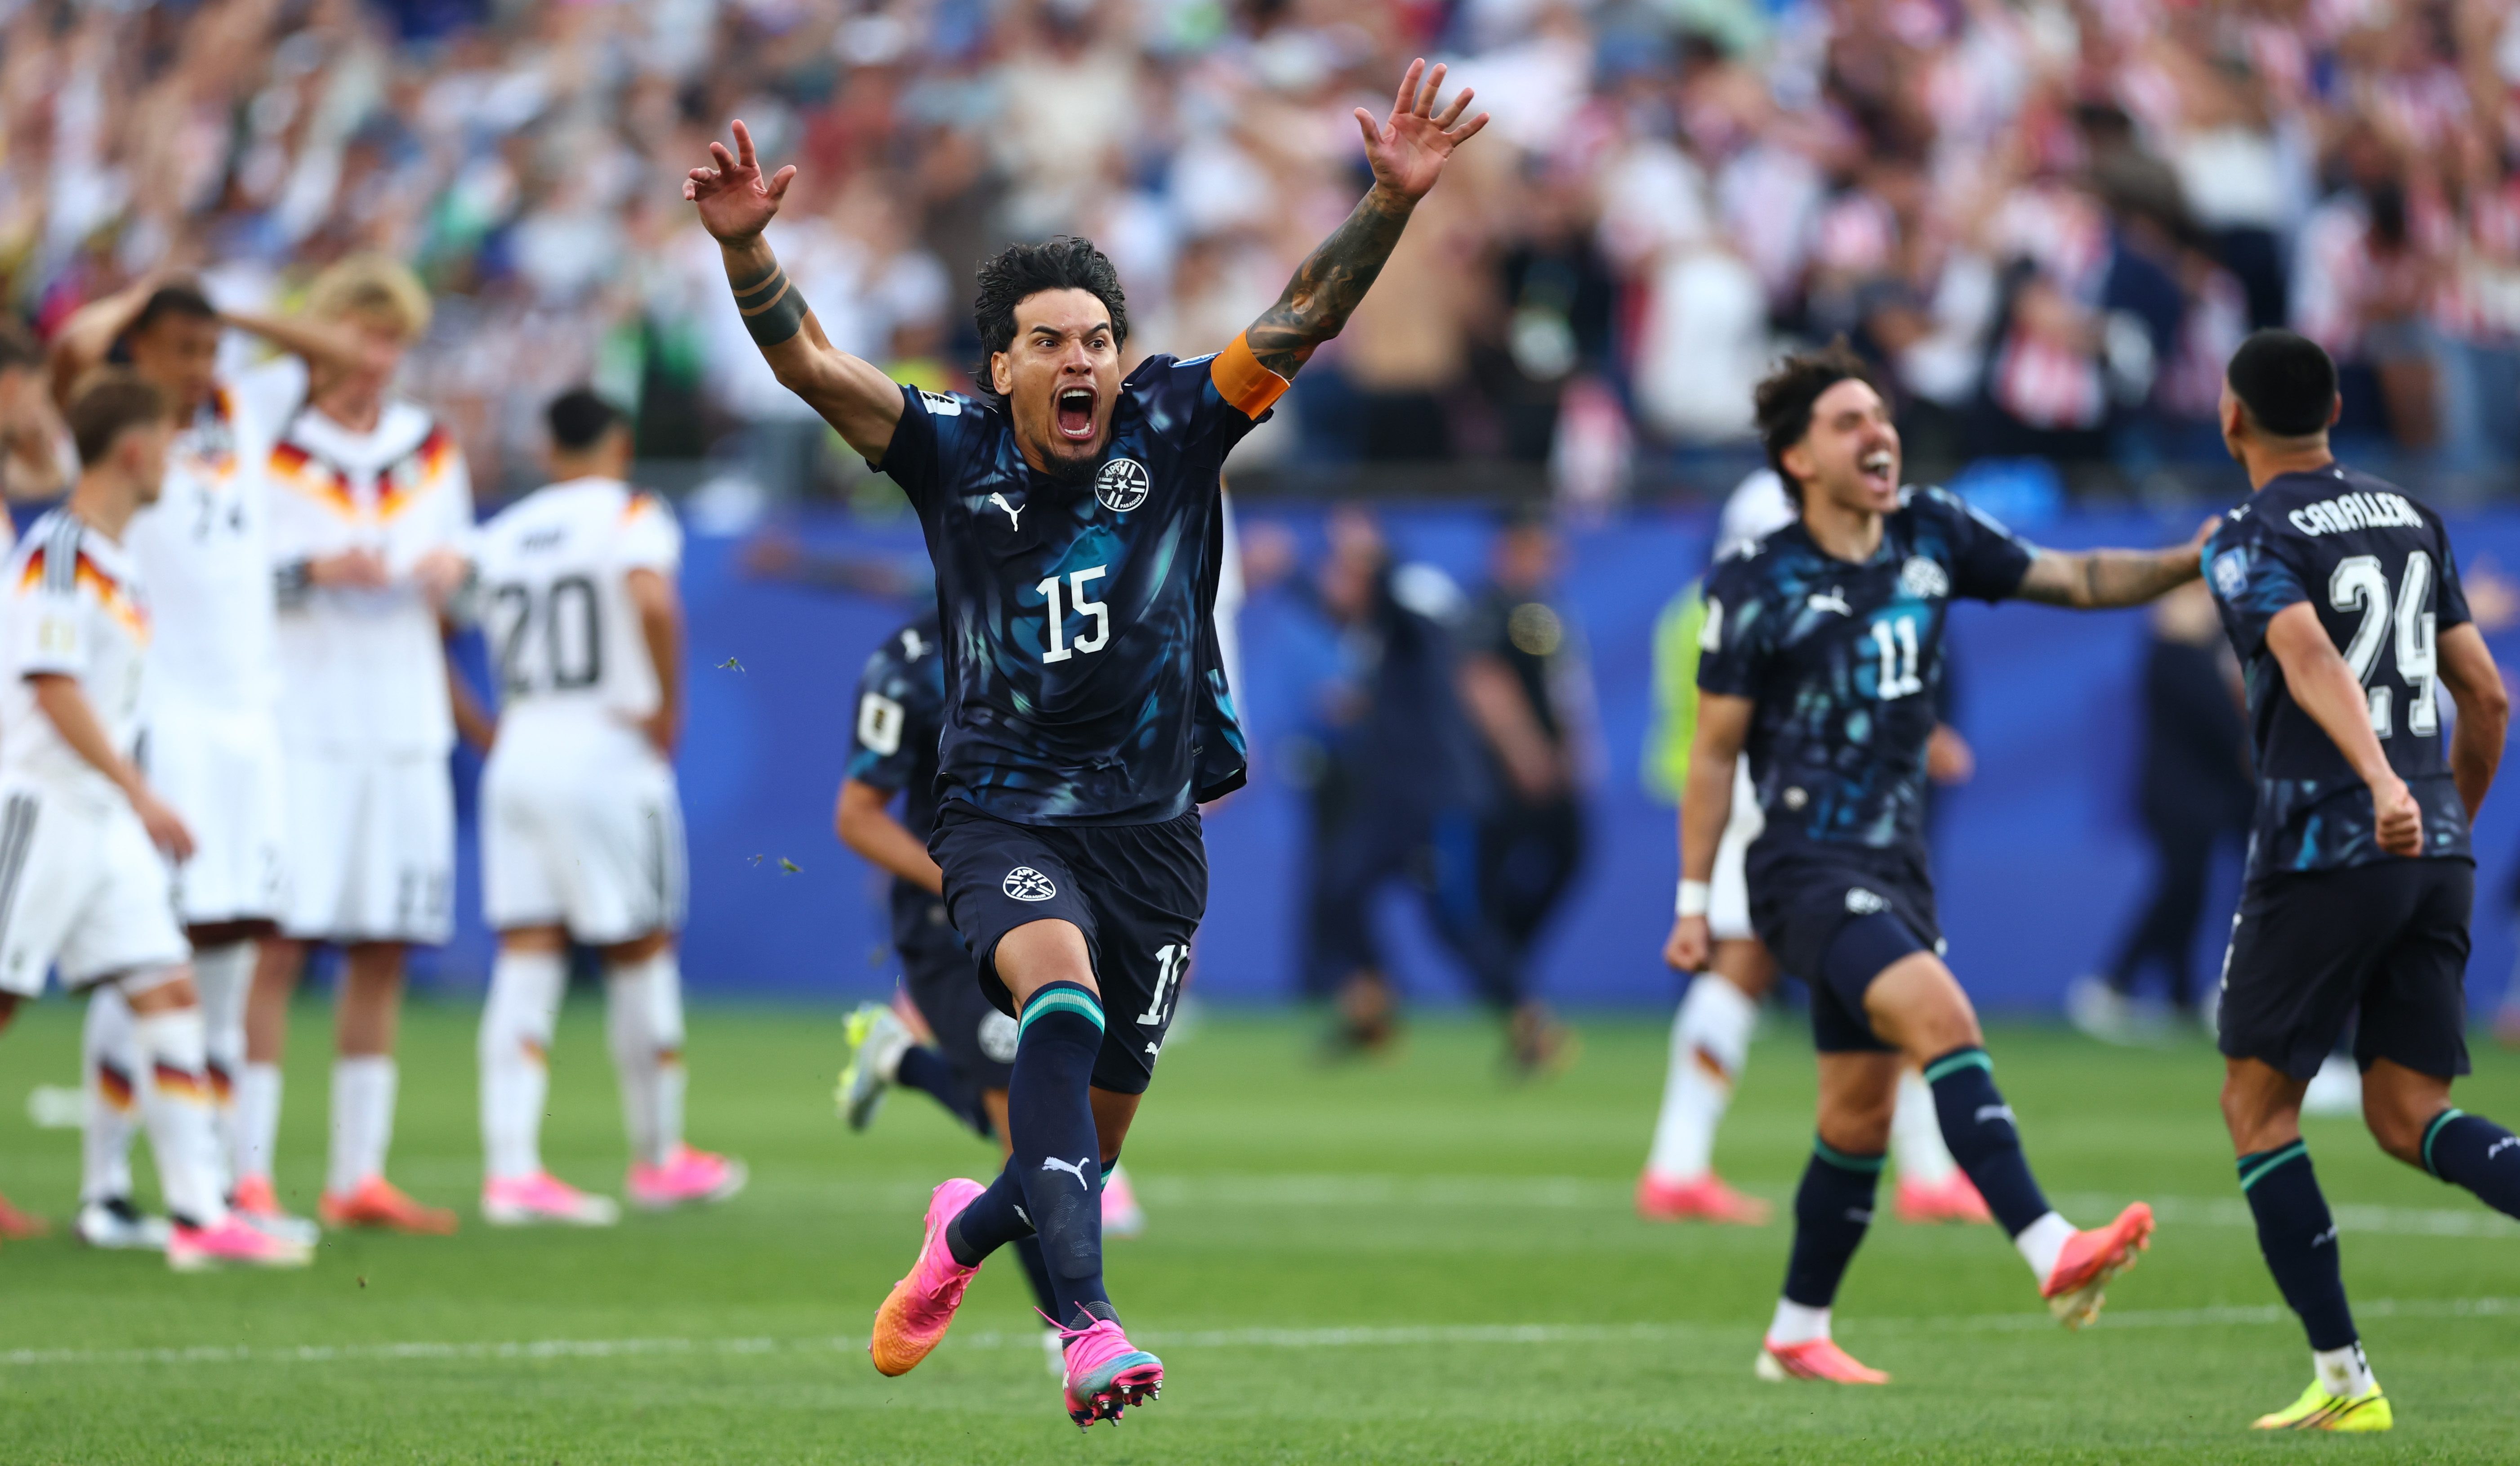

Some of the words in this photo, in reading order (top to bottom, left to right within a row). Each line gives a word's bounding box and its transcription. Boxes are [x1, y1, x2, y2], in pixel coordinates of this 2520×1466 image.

[1105, 462, 1120, 477] APF
[1120, 494, 1142, 508] PARAGUAY
[494, 575, 601, 693] 20
[1035, 564, 1109, 664] 15
[1871, 615, 1922, 700] 11
[2329, 550, 2437, 738] 24
